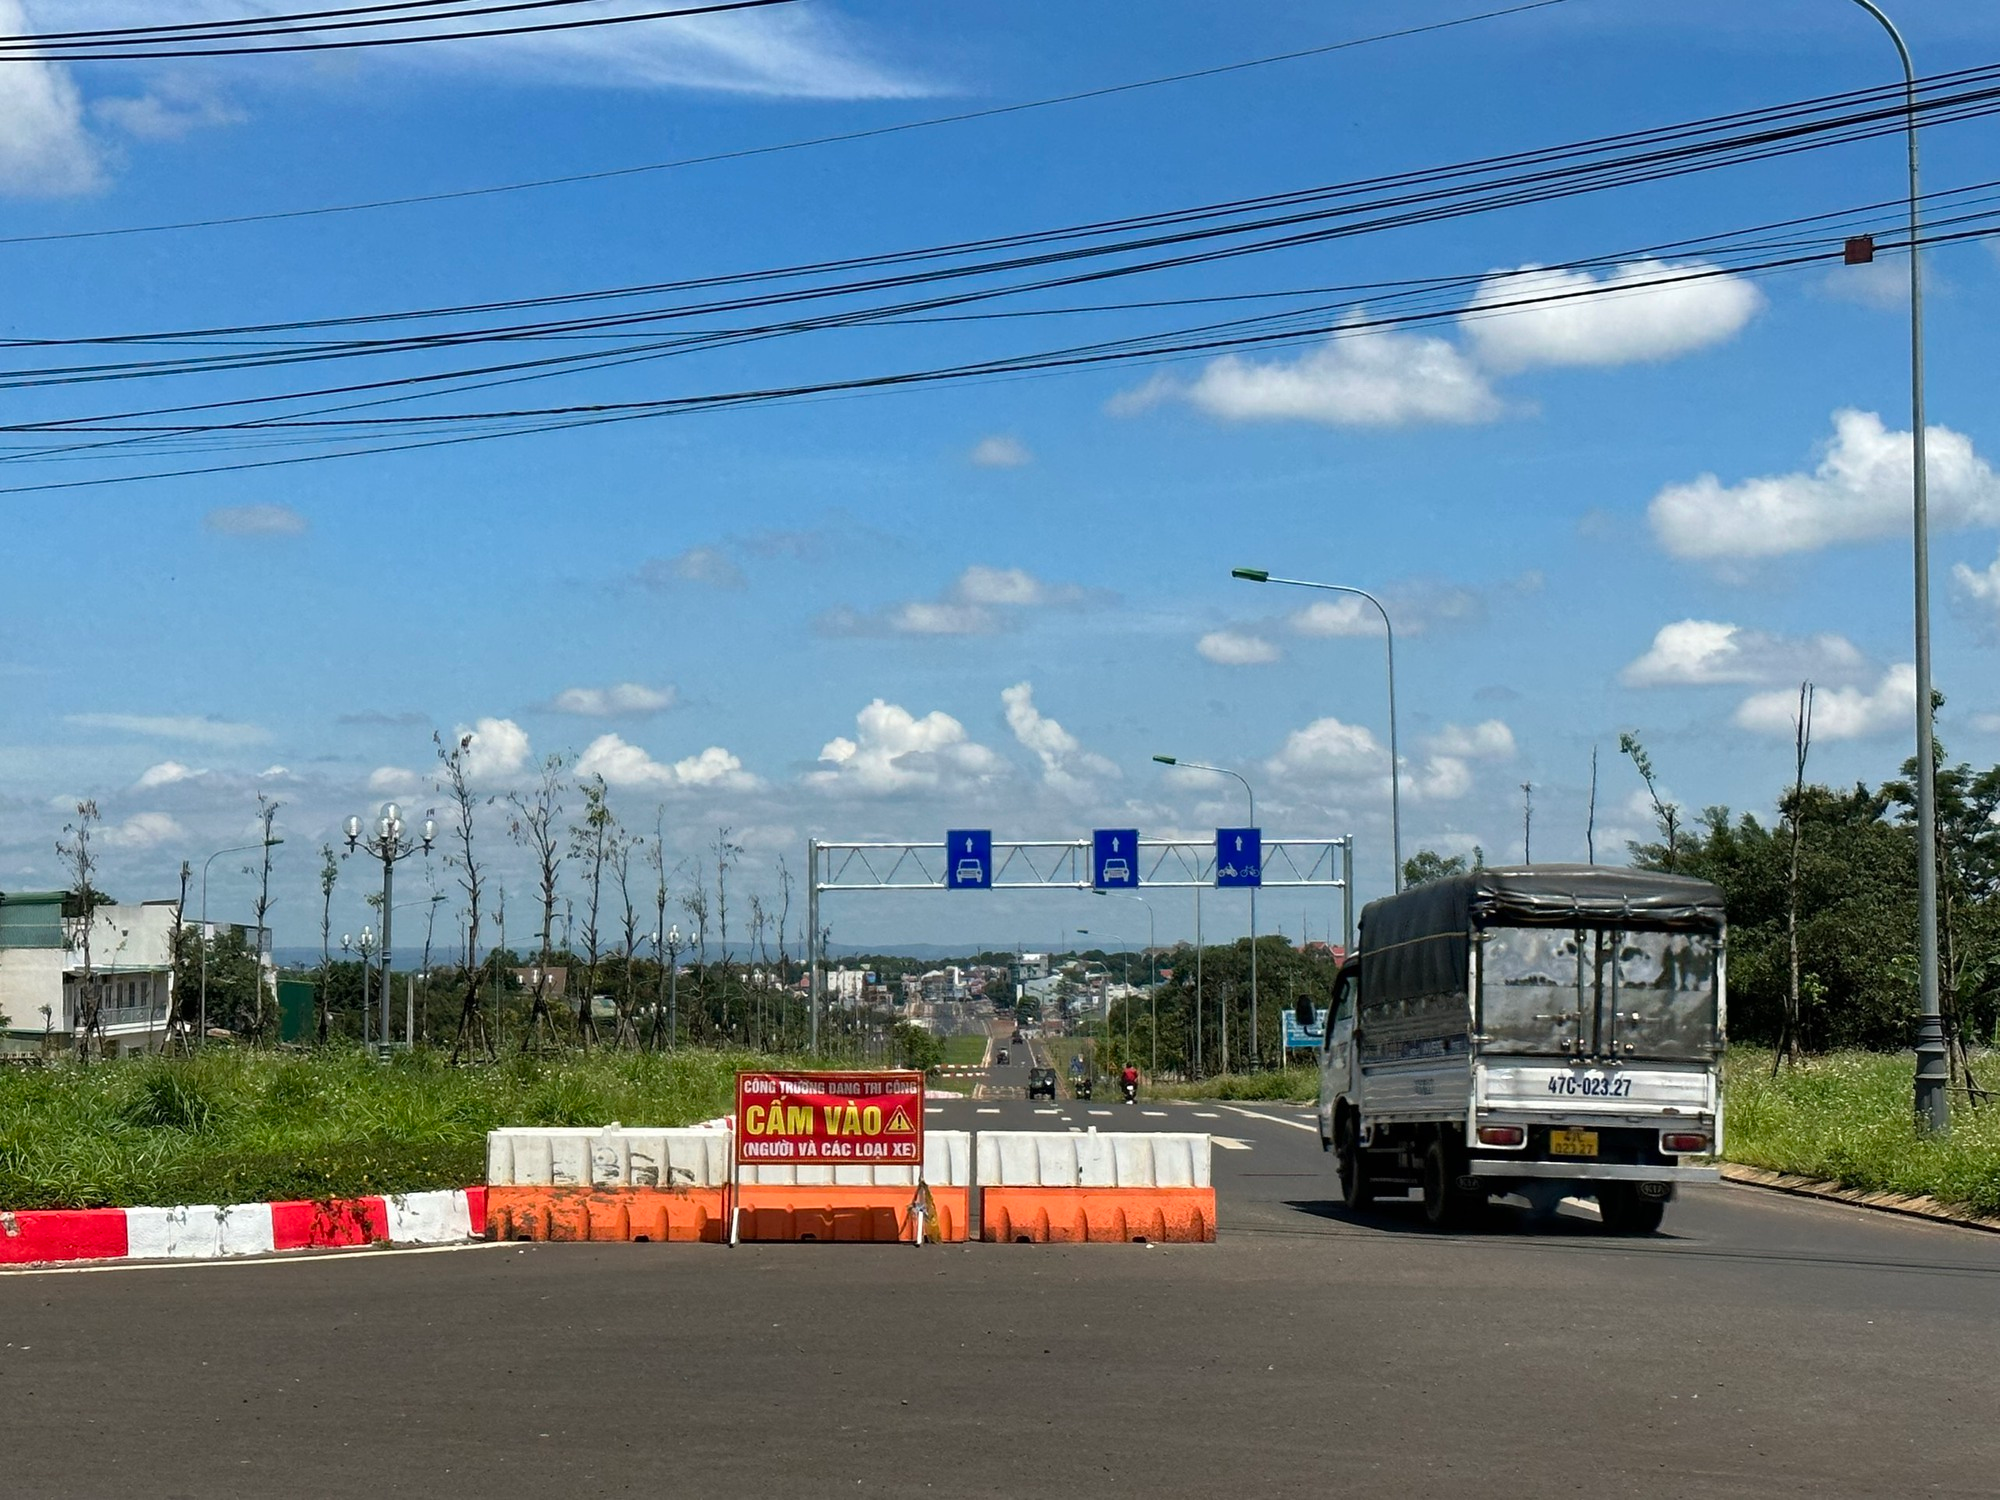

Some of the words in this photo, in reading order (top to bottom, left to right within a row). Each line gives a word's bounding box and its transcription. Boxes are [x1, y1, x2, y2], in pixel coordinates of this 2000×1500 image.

[744, 1077, 777, 1094] CÔNG
[885, 1079, 917, 1094] CÔNG
[1548, 1076, 1632, 1096] 47C-023.27
[747, 1096, 814, 1136] CẤM
[823, 1100, 882, 1136] VÀO
[743, 1139, 794, 1157] (NGƯỜI
[798, 1139, 817, 1156] VÀ
[821, 1140, 852, 1156] CÁC
[855, 1142, 888, 1159] LOẠI
[892, 1142, 916, 1158] XE)
